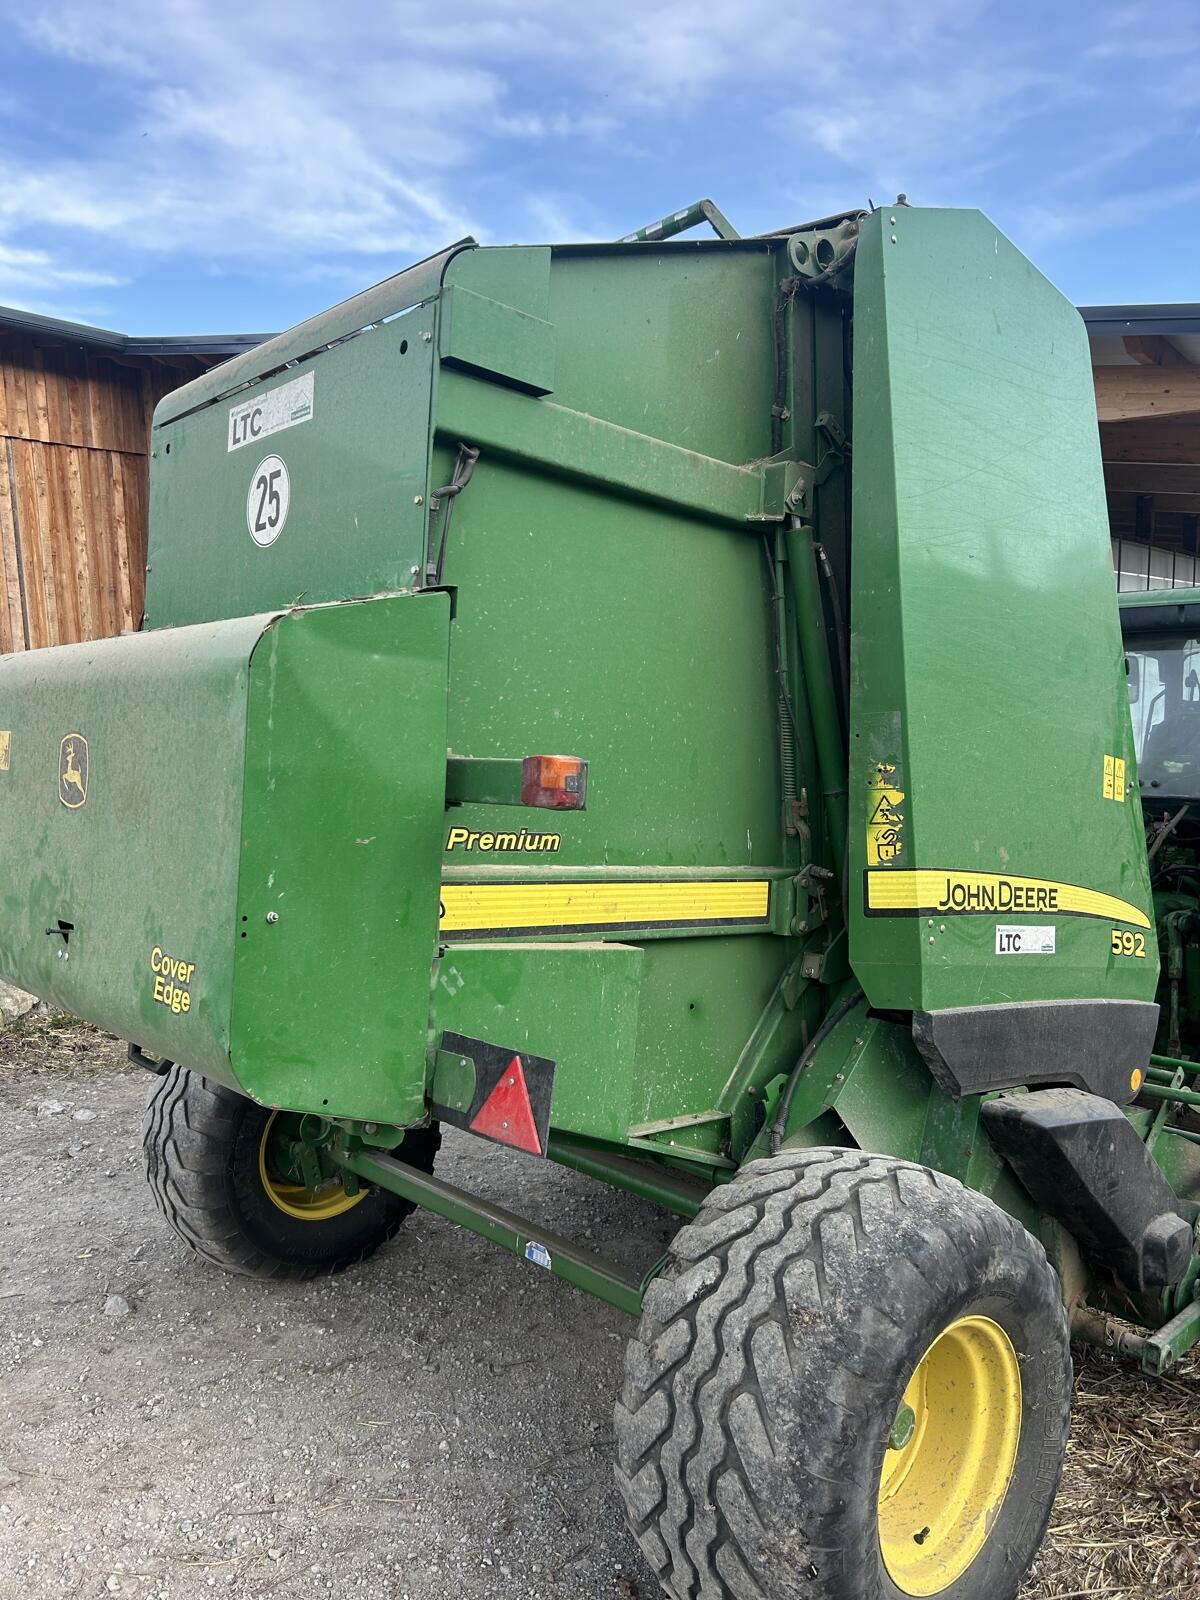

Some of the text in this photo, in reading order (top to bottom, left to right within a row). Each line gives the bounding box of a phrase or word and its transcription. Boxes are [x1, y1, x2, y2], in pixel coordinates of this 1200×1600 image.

[232, 407, 263, 446] LTC
[254, 468, 282, 533] 25
[445, 826, 561, 852] Premium
[939, 878, 1059, 909] JOHN DEERE
[999, 933, 1022, 952] LTC
[1110, 928, 1146, 958] 592
[150, 946, 196, 984] Cover
[153, 974, 192, 1014] Edge
